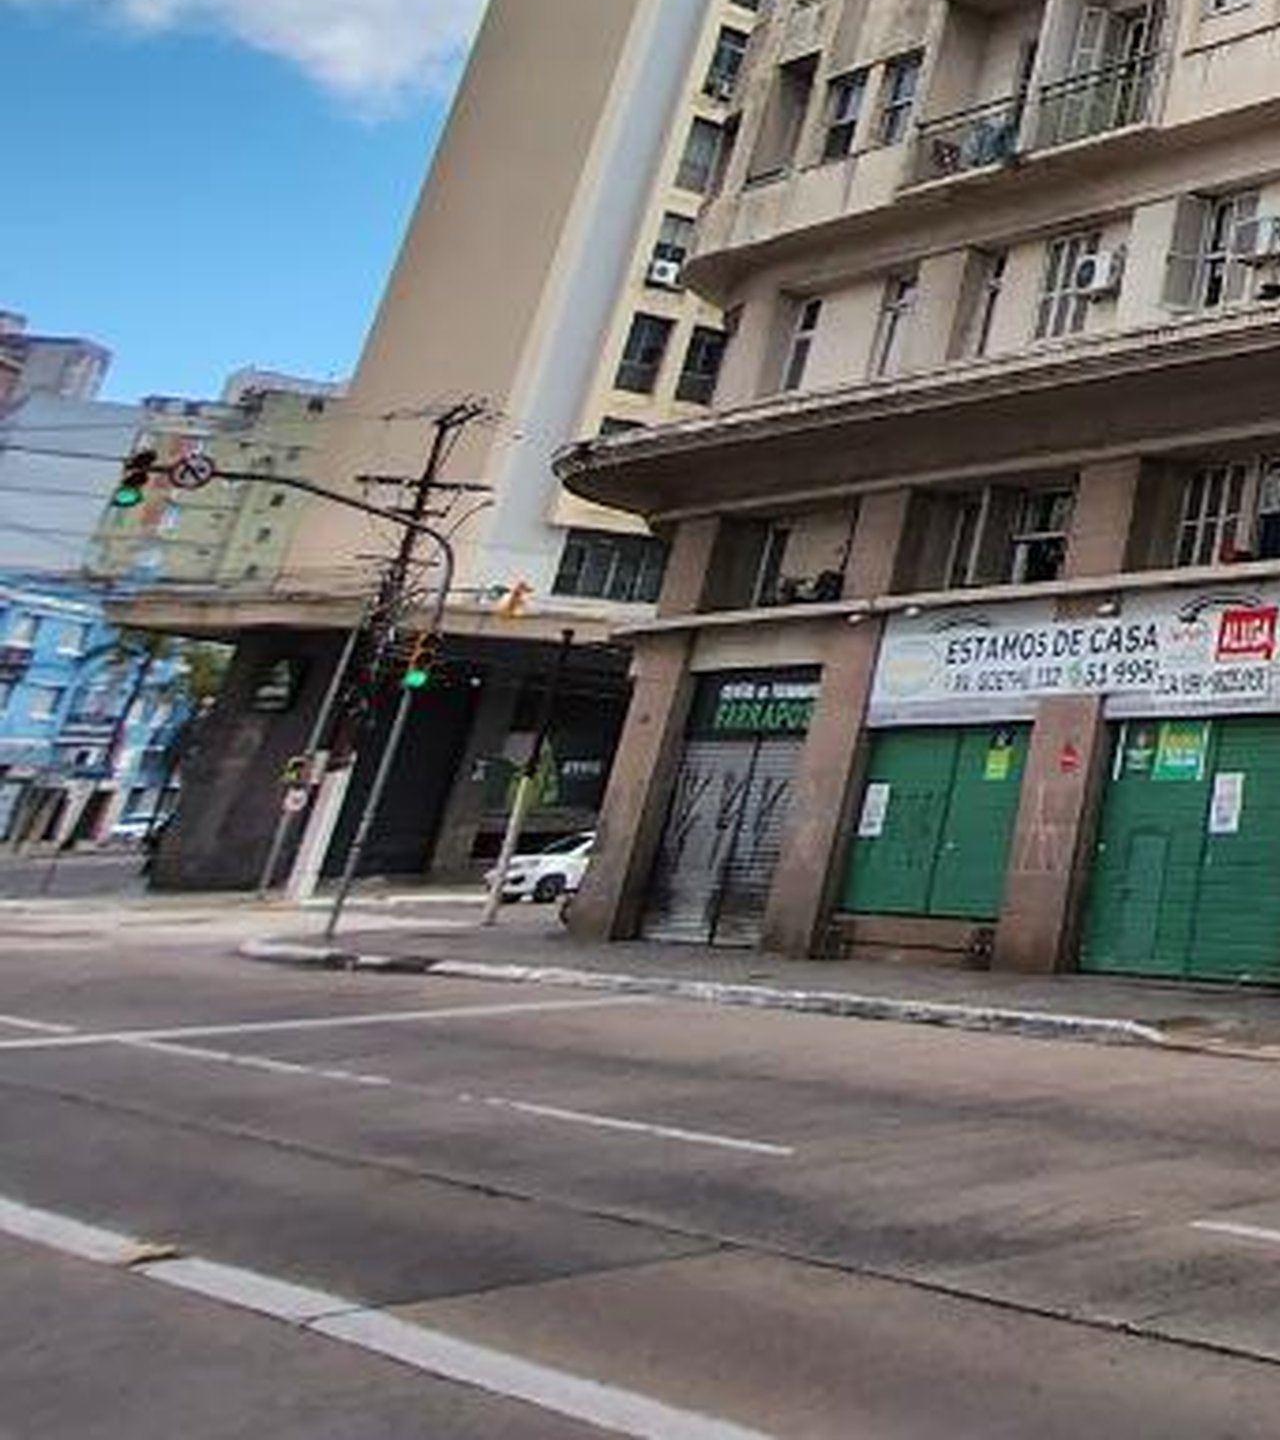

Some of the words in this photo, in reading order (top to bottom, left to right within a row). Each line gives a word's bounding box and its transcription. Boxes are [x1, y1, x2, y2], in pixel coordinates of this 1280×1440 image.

[946, 632, 1048, 665] ESTAMOS
[1052, 629, 1085, 657] DE
[1090, 623, 1159, 654] CASA
